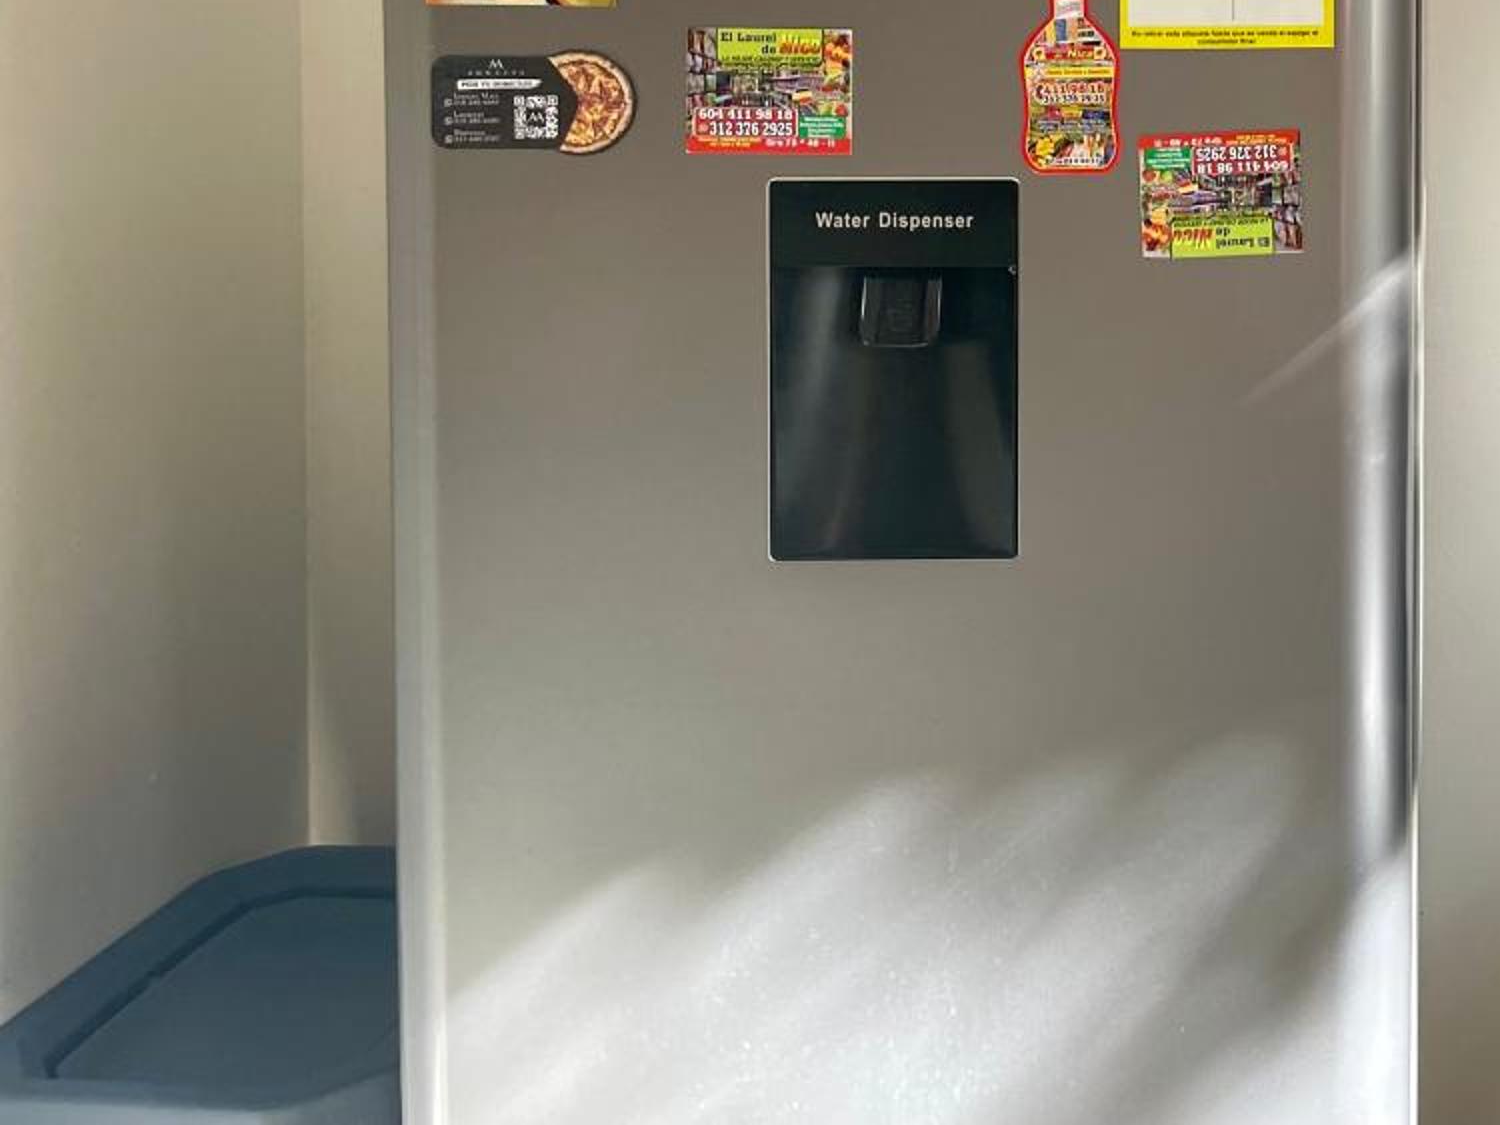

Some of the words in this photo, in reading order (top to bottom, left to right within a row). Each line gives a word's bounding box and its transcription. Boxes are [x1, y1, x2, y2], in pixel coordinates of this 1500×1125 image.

[709, 122, 733, 136] 312
[1254, 145, 1277, 157] 312
[815, 211, 870, 228] Water
[878, 211, 975, 232] Dispenser
